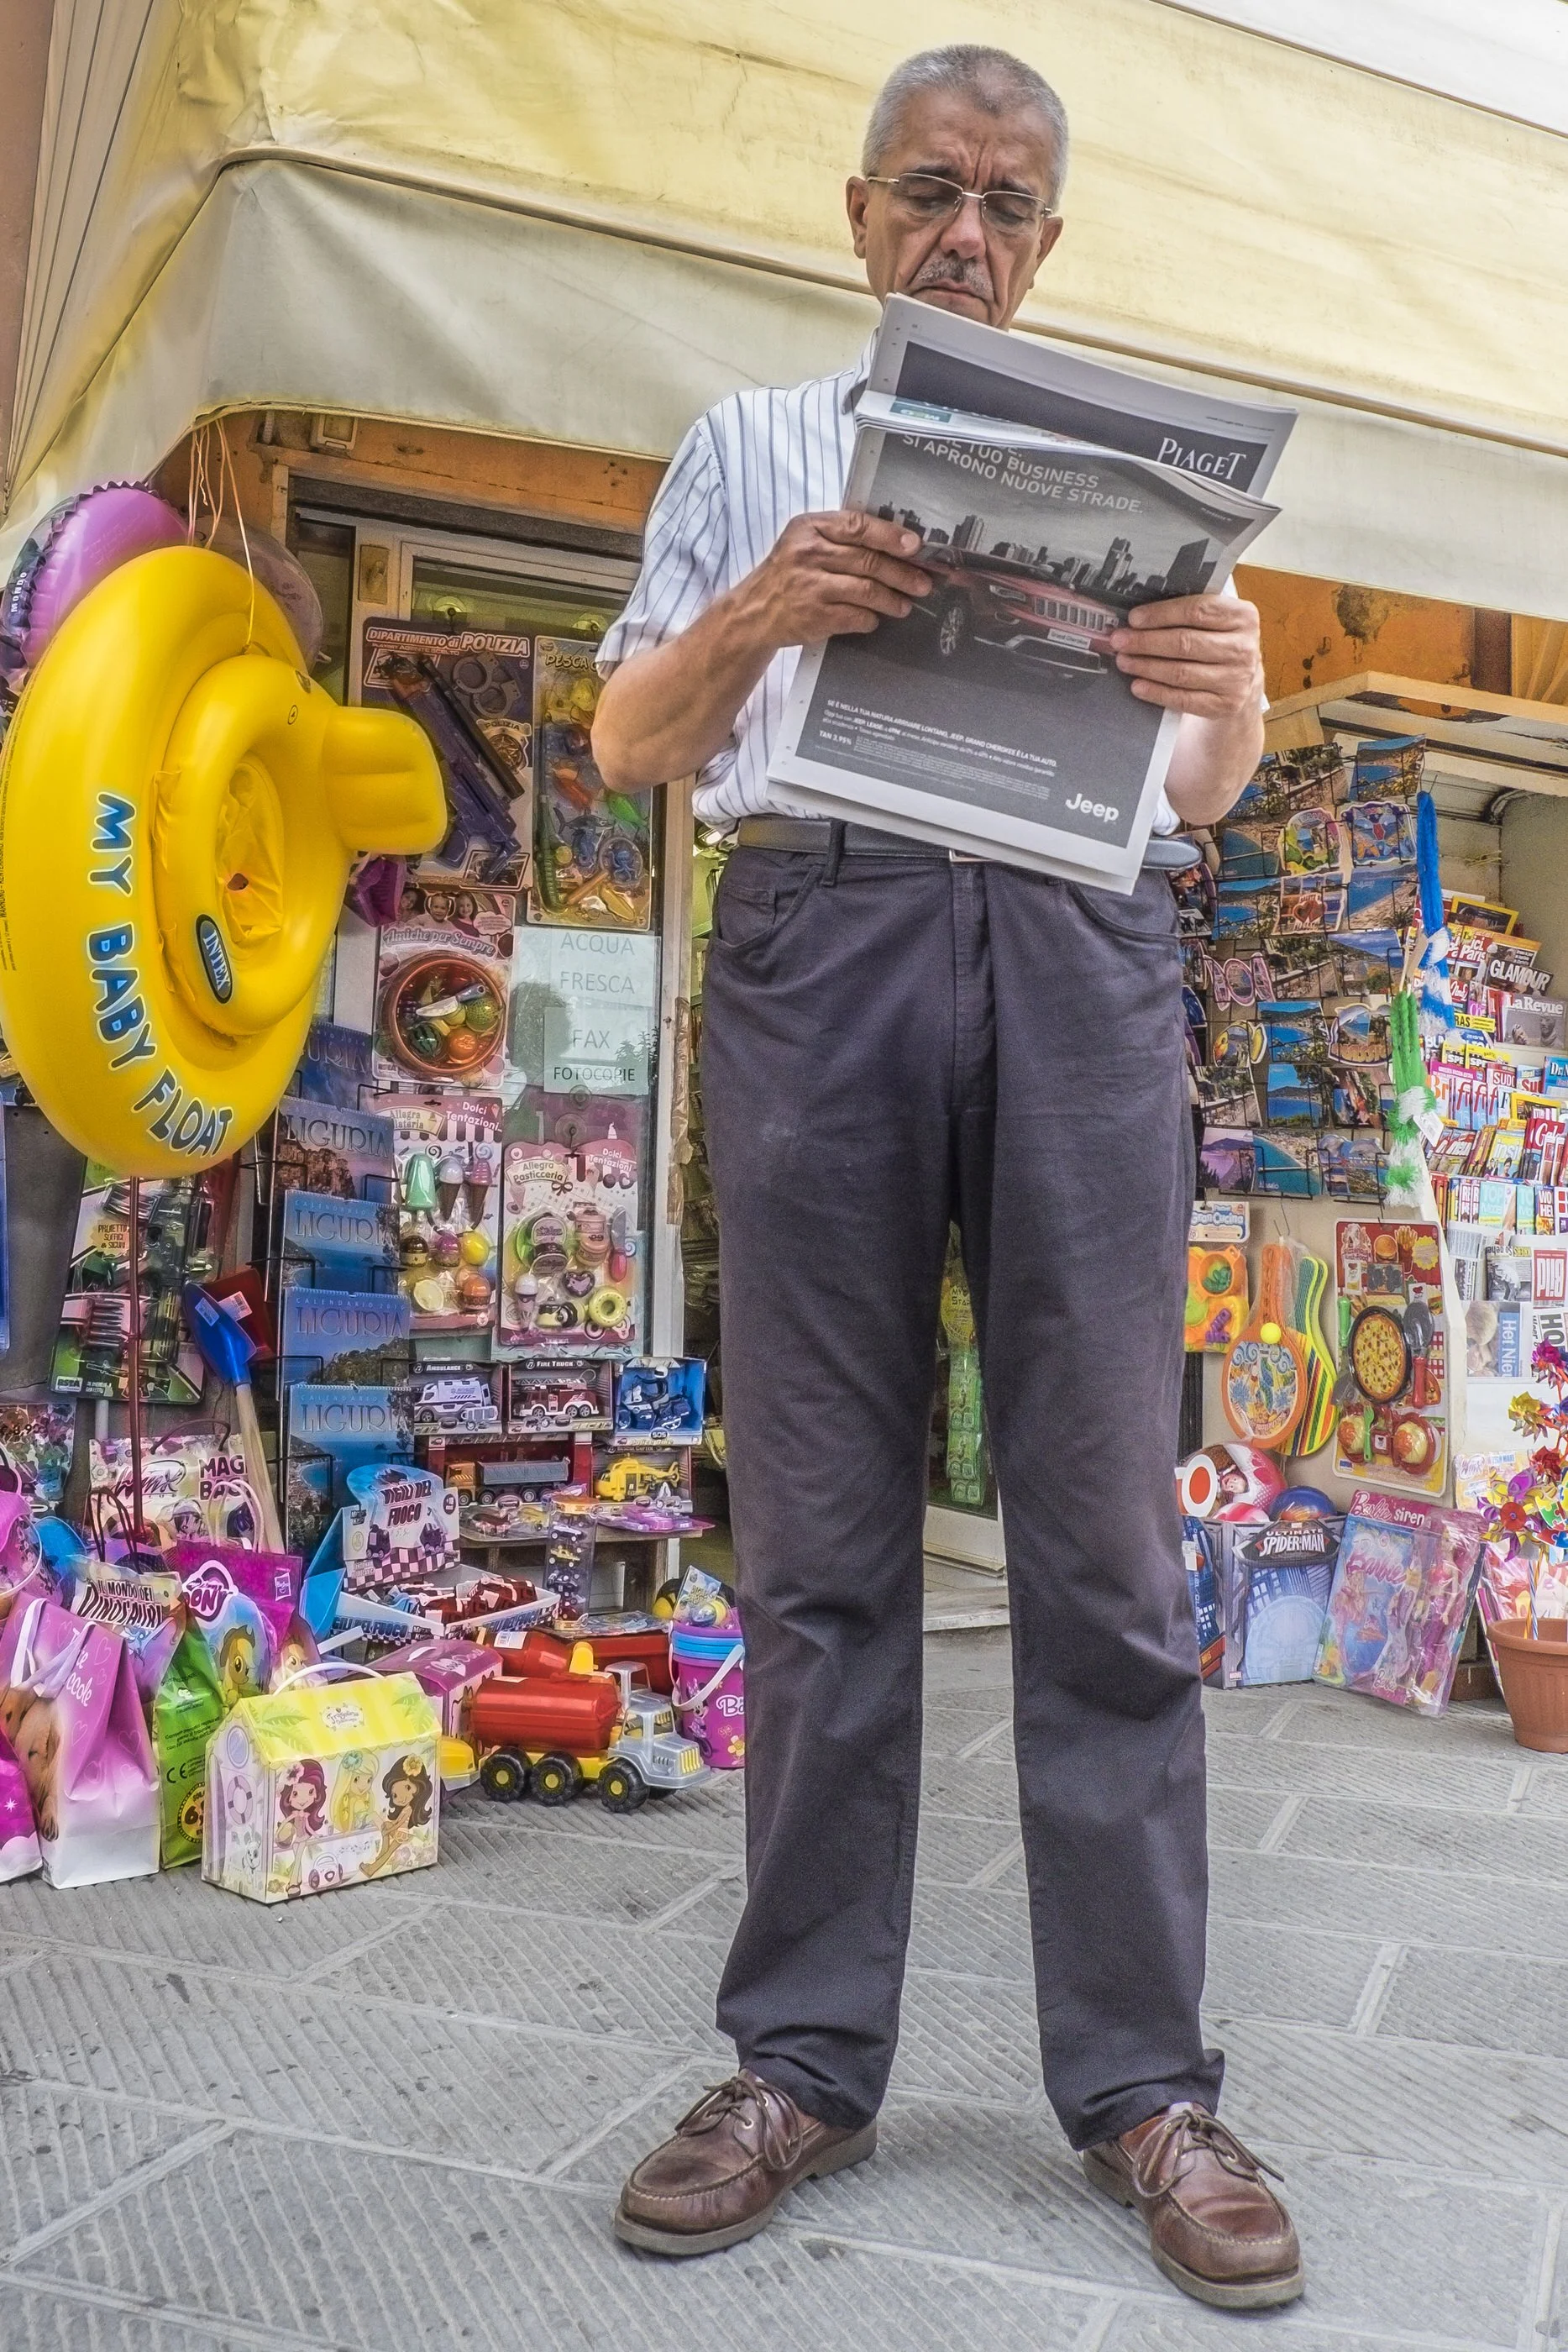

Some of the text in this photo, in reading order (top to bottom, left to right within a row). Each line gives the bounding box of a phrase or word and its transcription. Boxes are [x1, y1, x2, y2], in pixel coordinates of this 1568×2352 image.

[902, 433, 1144, 514] SI APRONO NUOVE STRADE.
[968, 443, 1004, 464] TUO
[1006, 455, 1100, 490] BUSINESS
[10, 571, 28, 613] MONDO
[368, 629, 529, 655] DIPARTIMENTO di POLIZIA
[545, 654, 588, 670] PESCA
[485, 722, 521, 732] POLIZIA
[819, 730, 832, 739] TAN
[1065, 793, 1120, 823] Jeep
[87, 791, 137, 898] MY
[383, 927, 496, 955] Amiche per Sempre
[560, 932, 635, 956] ACQUA
[202, 928, 231, 992] INTEX
[560, 971, 635, 995] FRESCA
[1489, 958, 1552, 991] GLAMOUR
[87, 921, 157, 1070] BABY
[1523, 996, 1564, 1015] Revue
[572, 1029, 611, 1049] FAX
[307, 1037, 367, 1075] URIA
[553, 1066, 636, 1082] FOTOCOPIE
[131, 1065, 233, 1159] FLOAT
[389, 1110, 422, 1121] Allegra
[462, 1101, 487, 1116] Dolci
[285, 1114, 390, 1158] LIGURIA
[590, 1153, 632, 1173] Tentazioni
[602, 1147, 622, 1159] Dolci
[513, 1169, 564, 1182] Pasticceria
[522, 1162, 554, 1172] Allegra
[294, 1209, 395, 1247] LIGURIA
[1536, 1257, 1565, 1299] Bild
[296, 1297, 375, 1309] CALENDARIO
[295, 1305, 405, 1338] LIGURIA
[1502, 1319, 1517, 1341] Het
[300, 1403, 411, 1434] LIGURIA
[380, 1478, 433, 1505] VIGILI DEL
[387, 1503, 422, 1527] FUOCO
[1350, 1491, 1392, 1522] Barbie
[1266, 1527, 1324, 1537] ULTIMATE
[1259, 1534, 1326, 1557] SPIDER-MAN
[1345, 1551, 1407, 1586] Barbie
[97, 1580, 154, 1602] IL MONDO DEI
[76, 1581, 164, 1630] DINOSAURI
[371, 1622, 409, 1639] FUOCO
